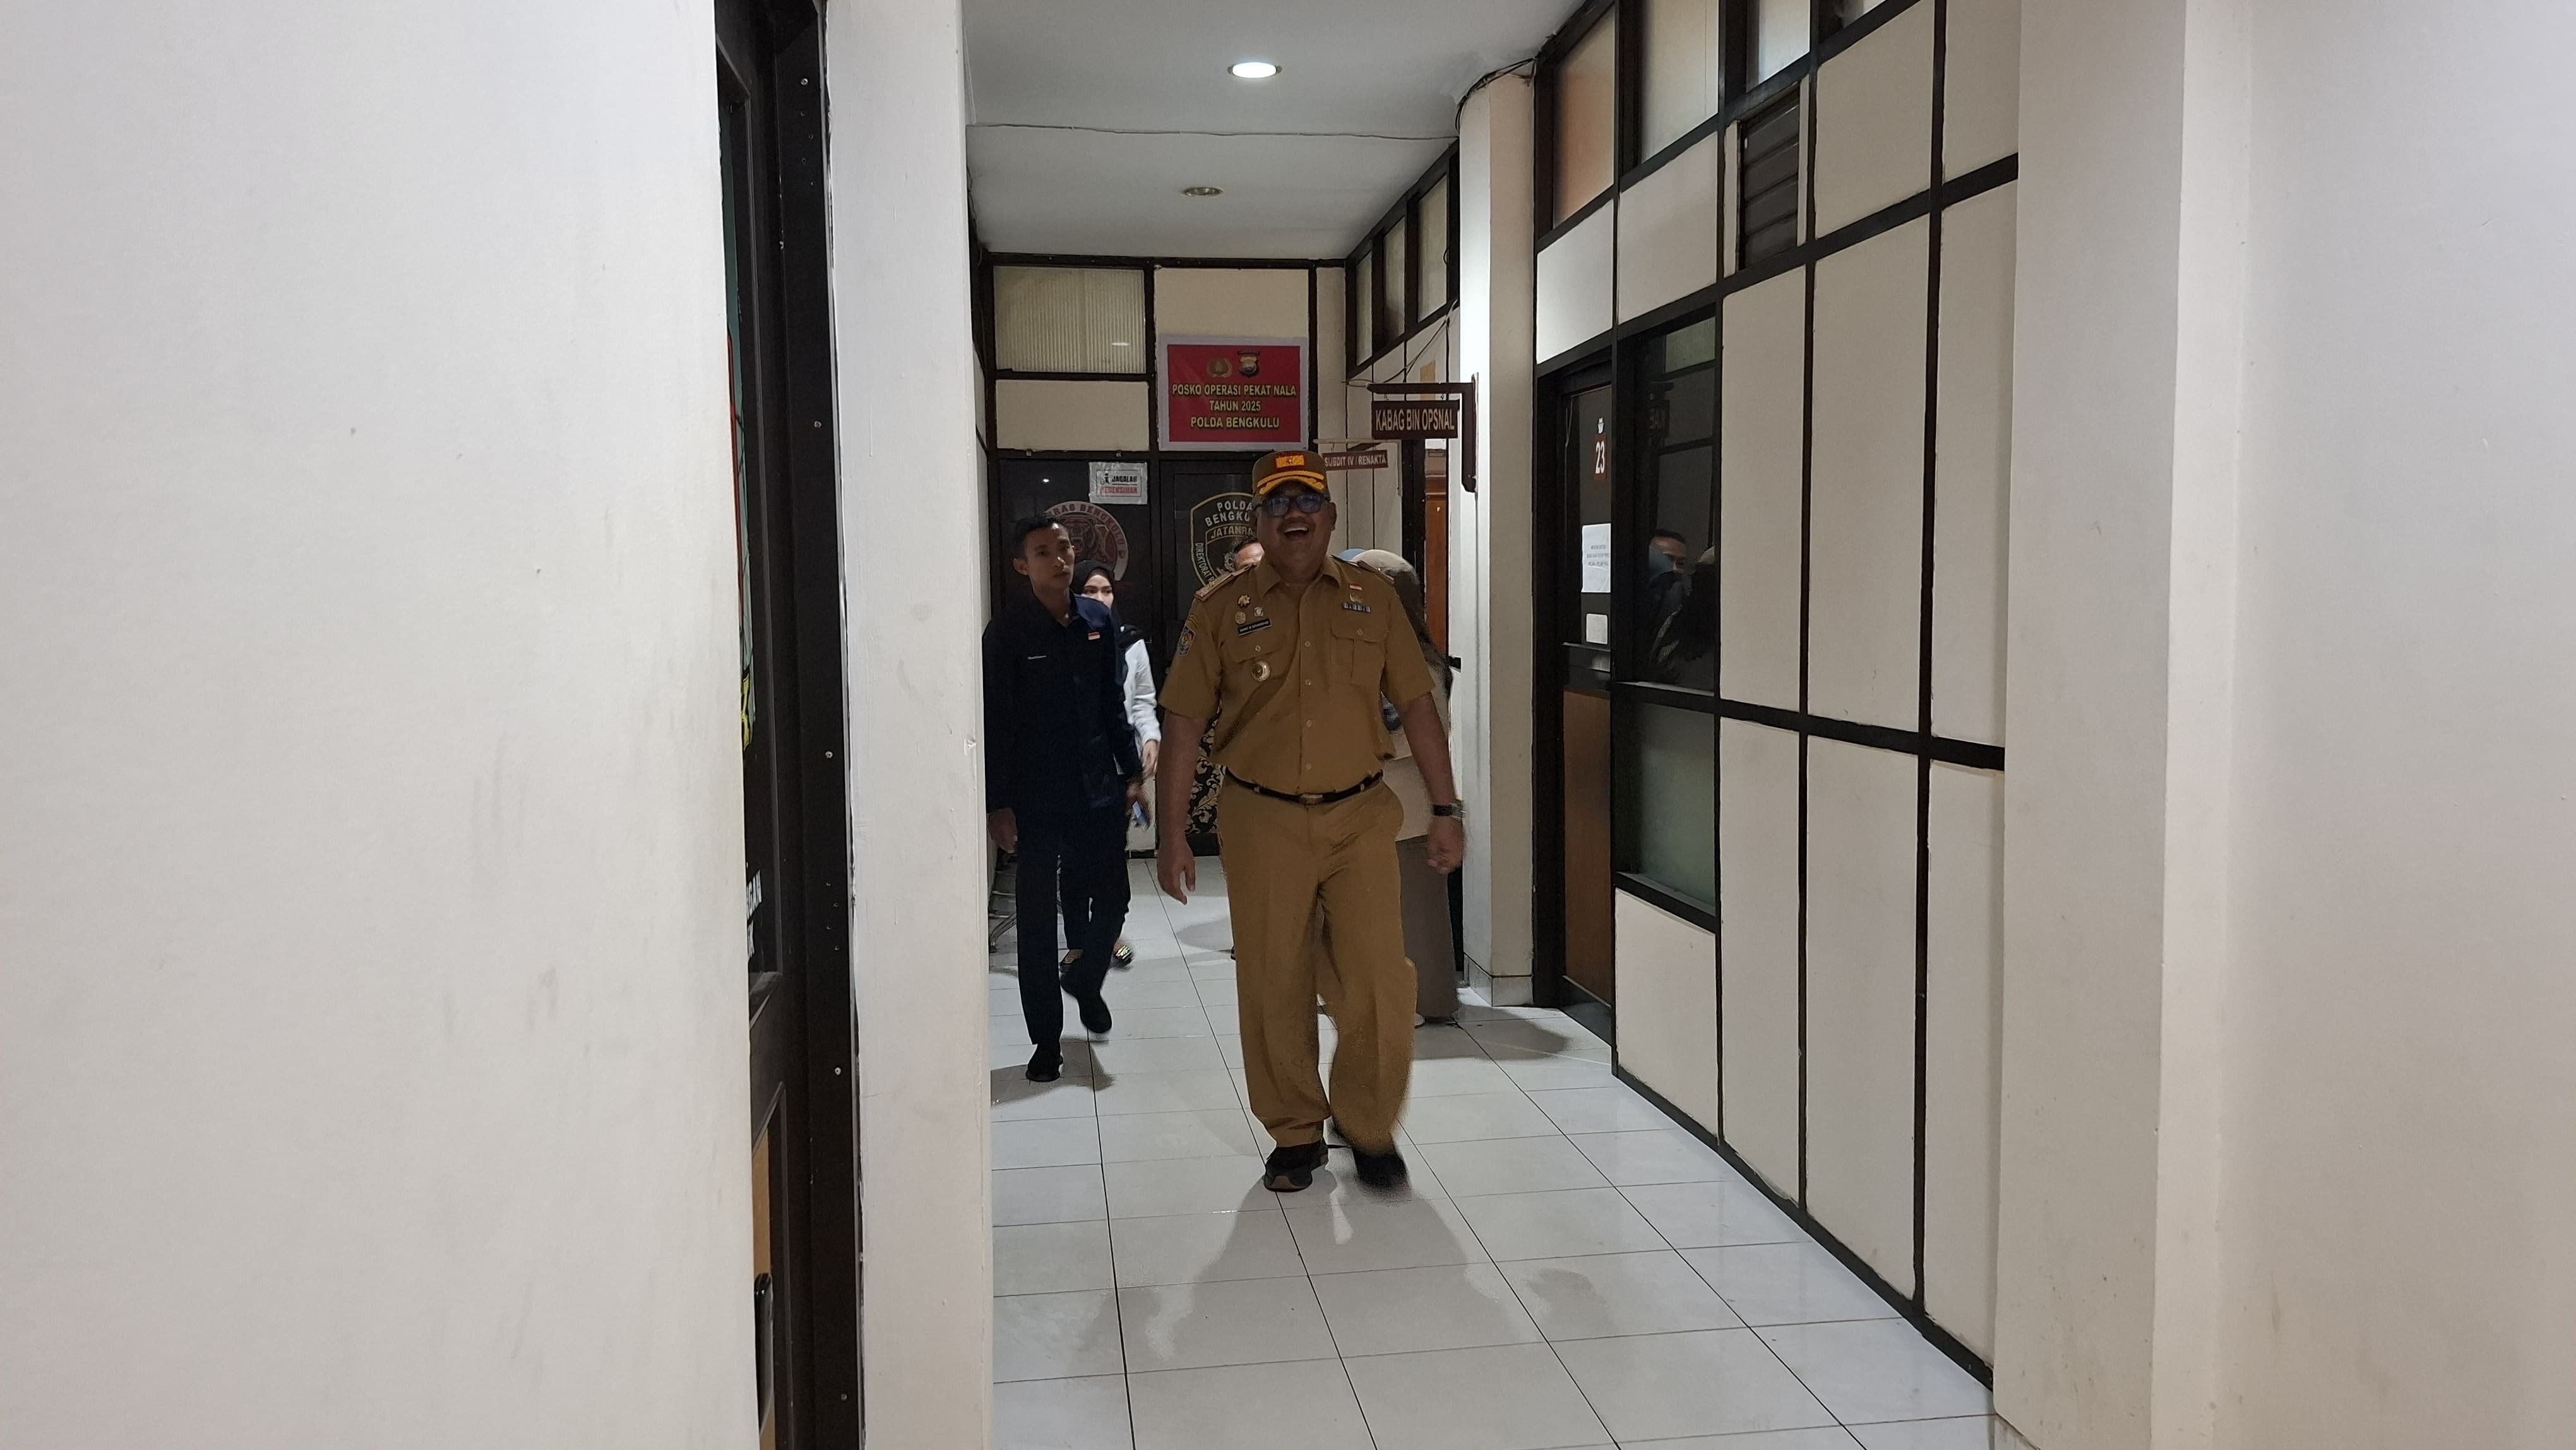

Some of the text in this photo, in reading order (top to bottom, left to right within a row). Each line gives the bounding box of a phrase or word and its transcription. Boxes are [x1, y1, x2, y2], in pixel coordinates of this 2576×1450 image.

[1172, 384, 1296, 396] POSKO OPERASI PEKAT NALA
[1210, 400, 1261, 412] TAHUN 2025
[1191, 417, 1280, 428] POLDA BENGKULU
[1376, 409, 1455, 431] KABAG BIN OPSNAL
[1325, 457, 1346, 467] SUBDIT
[1348, 456, 1354, 465] IV
[1358, 454, 1386, 465] RENAKTA
[1595, 440, 1605, 474] 23
[1217, 500, 1253, 512] POLDA
[1204, 512, 1251, 527] BENGKU
[1210, 525, 1254, 539] JATANRA
[1195, 542, 1212, 579] DIREKTORAT
